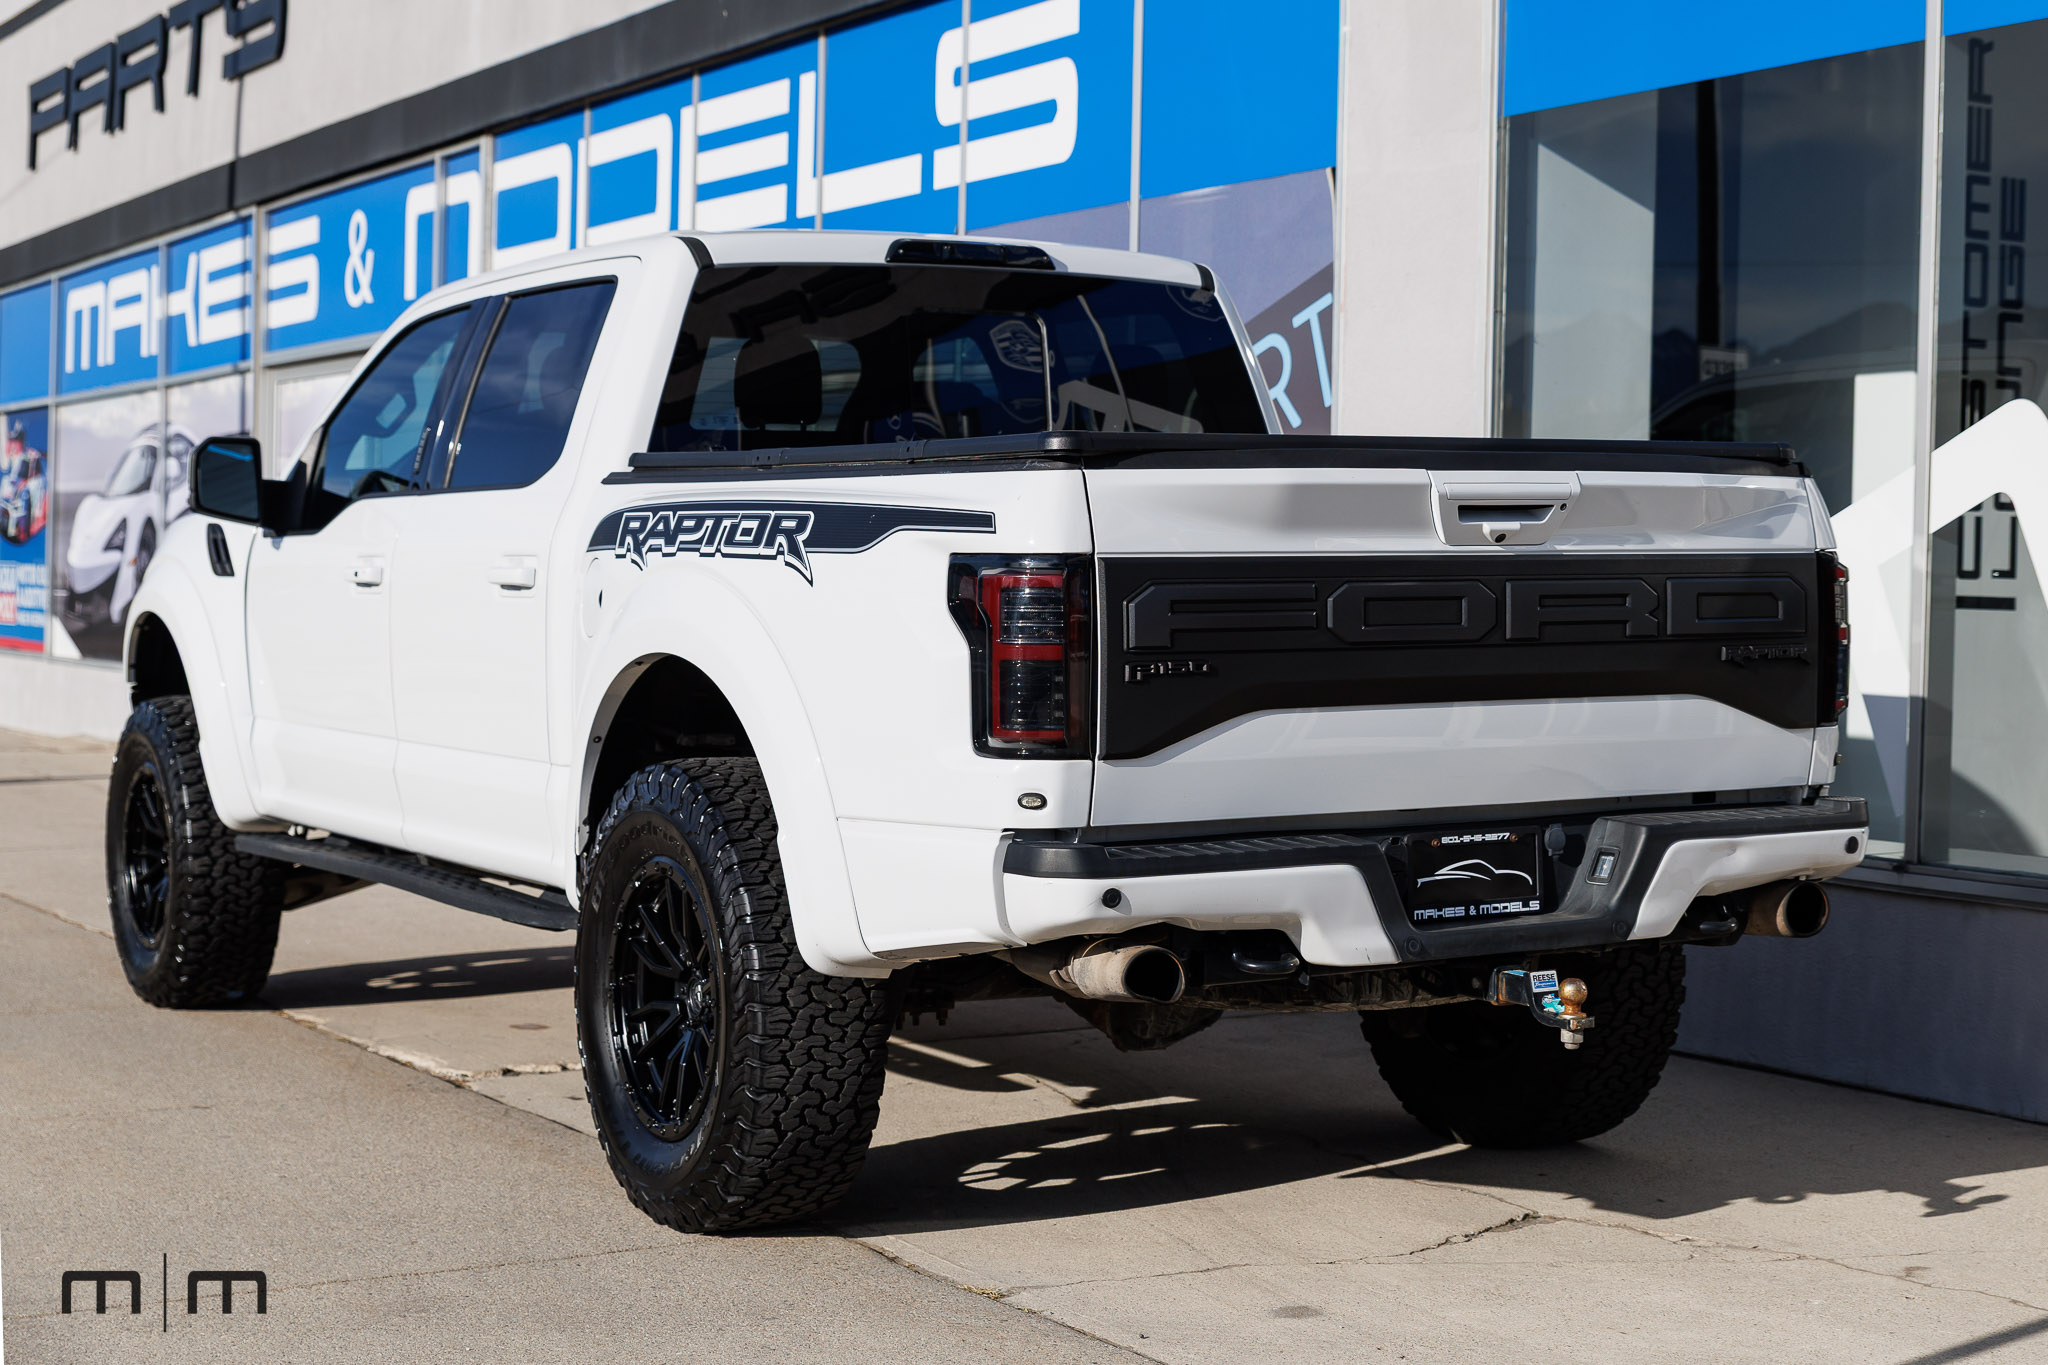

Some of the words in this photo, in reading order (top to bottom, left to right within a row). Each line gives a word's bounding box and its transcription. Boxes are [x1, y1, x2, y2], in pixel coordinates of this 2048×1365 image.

[28, 0, 287, 171] PARTS
[65, 213, 320, 374] MAKES
[344, 208, 375, 308] &
[403, 0, 1080, 301] MODELS
[615, 510, 814, 587] RAPTOR
[1123, 576, 1808, 654] FORD
[1414, 906, 1465, 920] MAKES
[1469, 905, 1477, 915] &
[1479, 900, 1540, 915] MODELS
[1532, 973, 1556, 981] REESE
